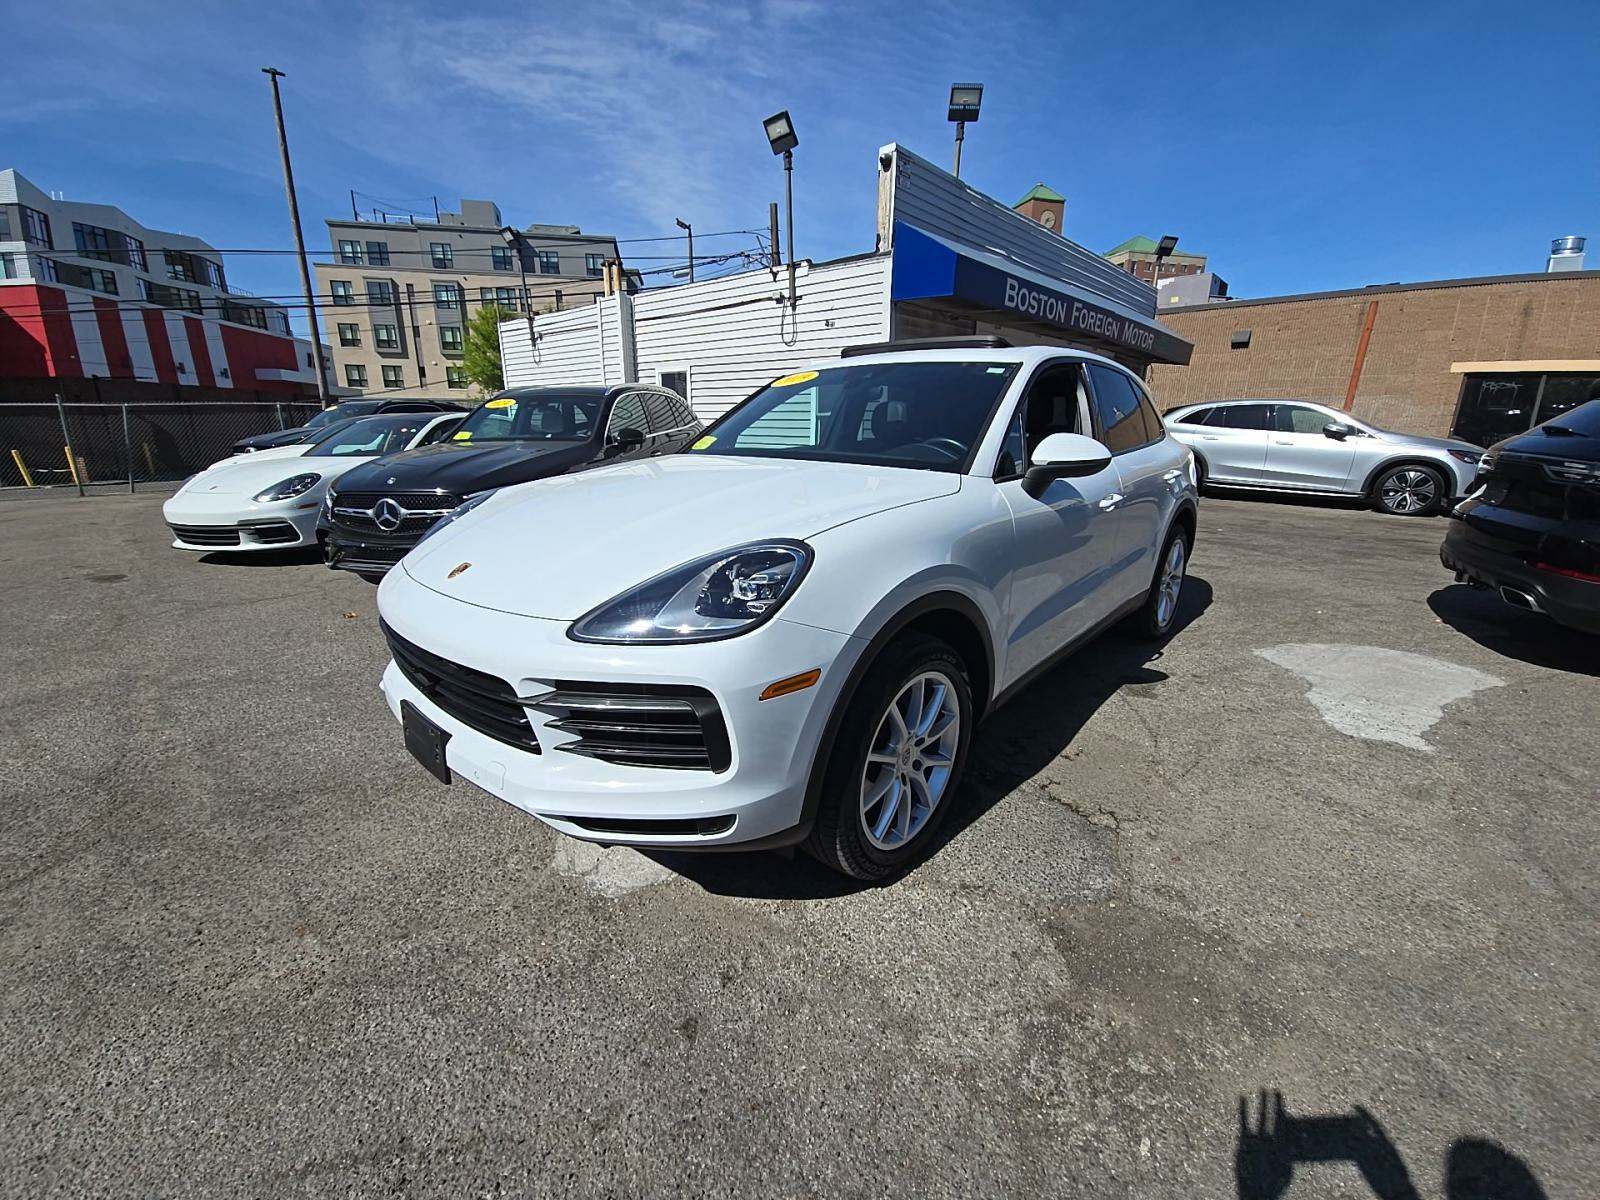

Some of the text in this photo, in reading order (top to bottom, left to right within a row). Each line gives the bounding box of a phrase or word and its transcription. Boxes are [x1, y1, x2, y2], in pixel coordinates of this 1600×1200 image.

[1004, 277, 1155, 350] BOSTON FOREIGN MOTOR
